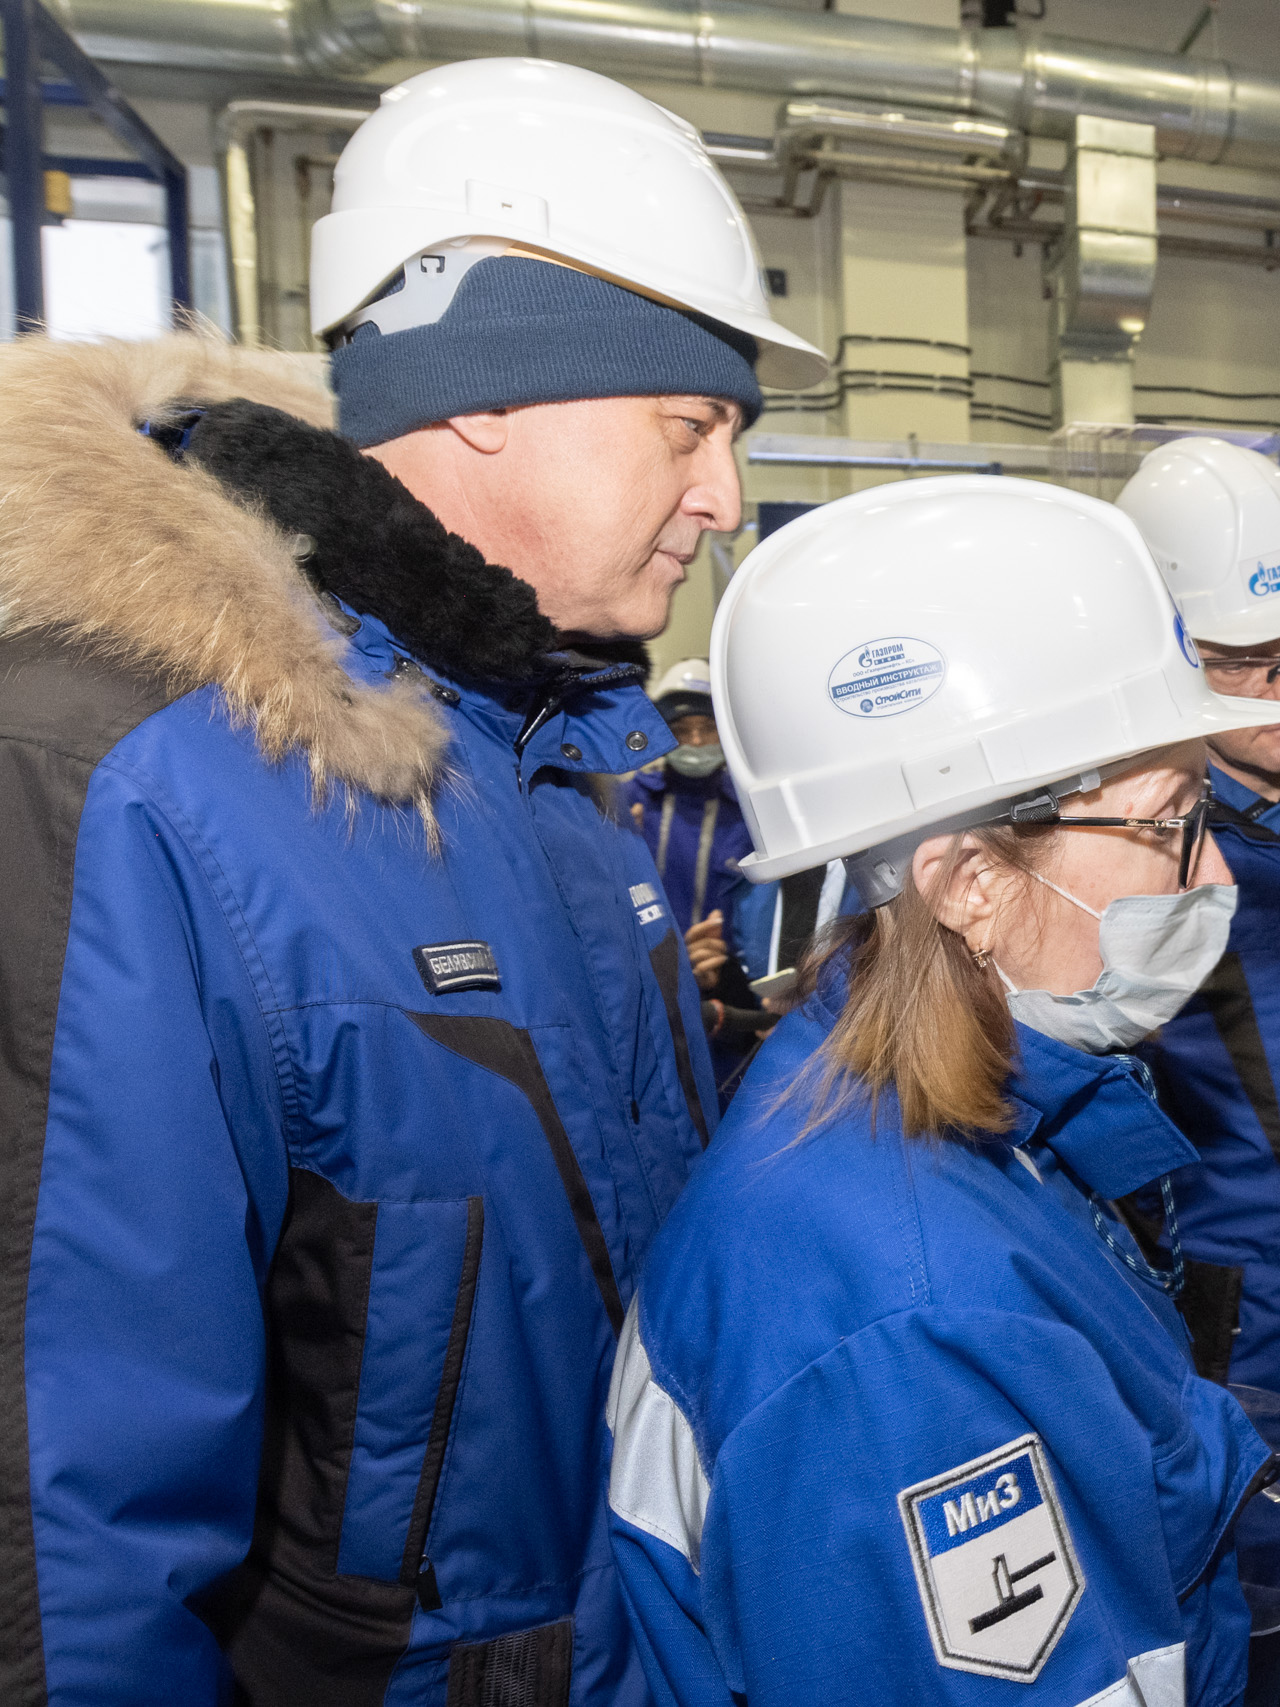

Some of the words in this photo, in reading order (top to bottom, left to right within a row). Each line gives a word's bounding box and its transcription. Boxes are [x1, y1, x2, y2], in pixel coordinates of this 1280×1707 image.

[872, 643, 904, 658] ГАЗПРОМ
[836, 676, 879, 696] ВВОДНЫЙ
[880, 664, 938, 685] ИНСТРУКТАЖ
